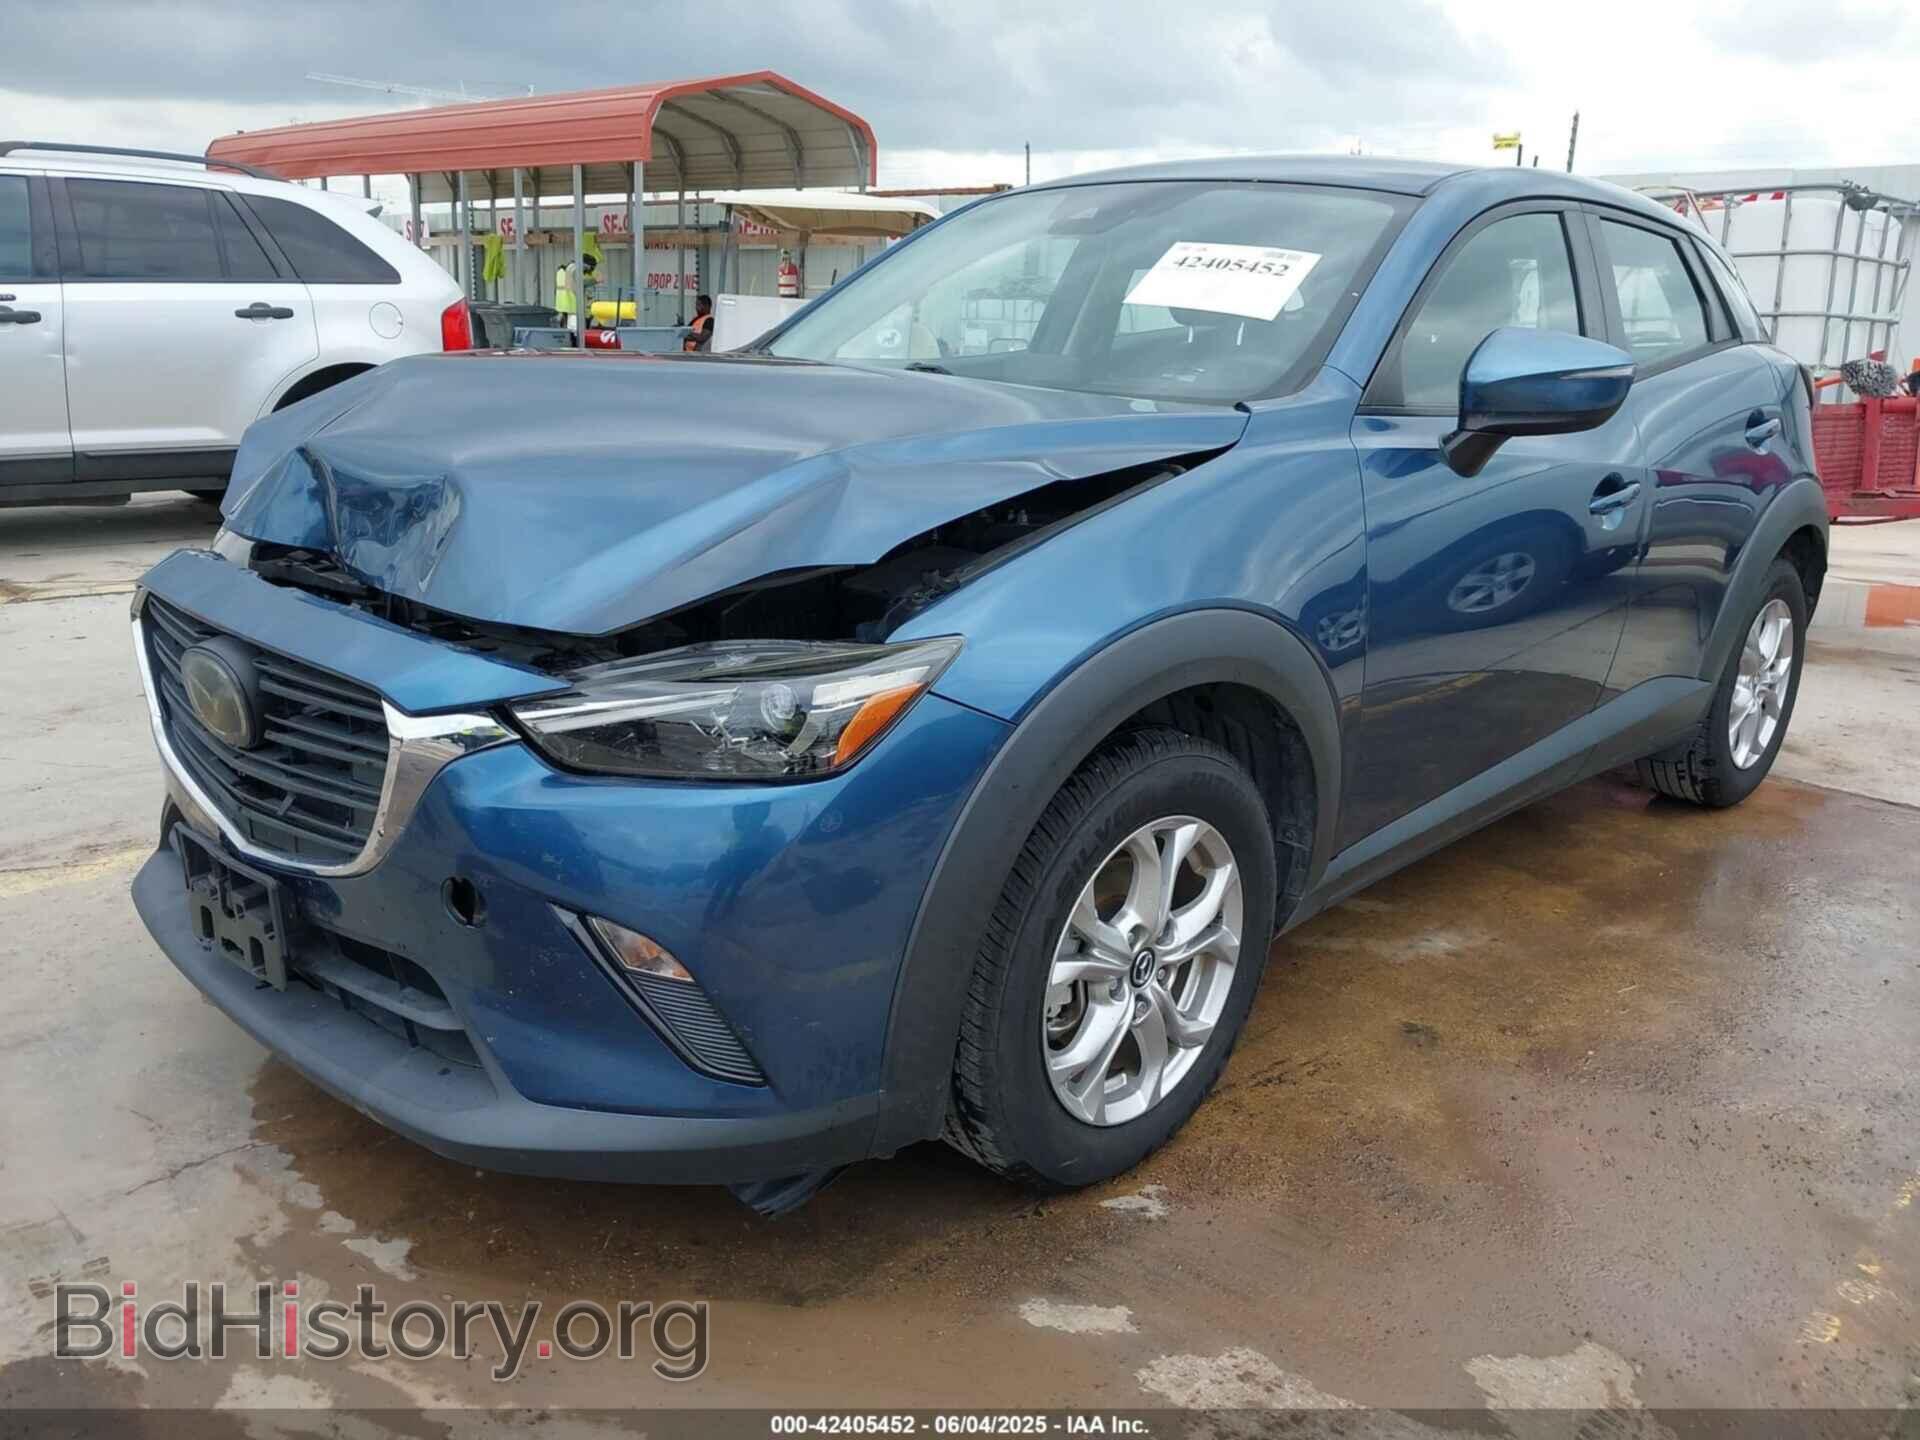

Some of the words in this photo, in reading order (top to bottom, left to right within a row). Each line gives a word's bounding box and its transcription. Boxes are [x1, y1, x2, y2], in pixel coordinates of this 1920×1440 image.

[1174, 255, 1290, 277] 42405452
[647, 272, 672, 289] DROP
[673, 273, 698, 290] ZNE
